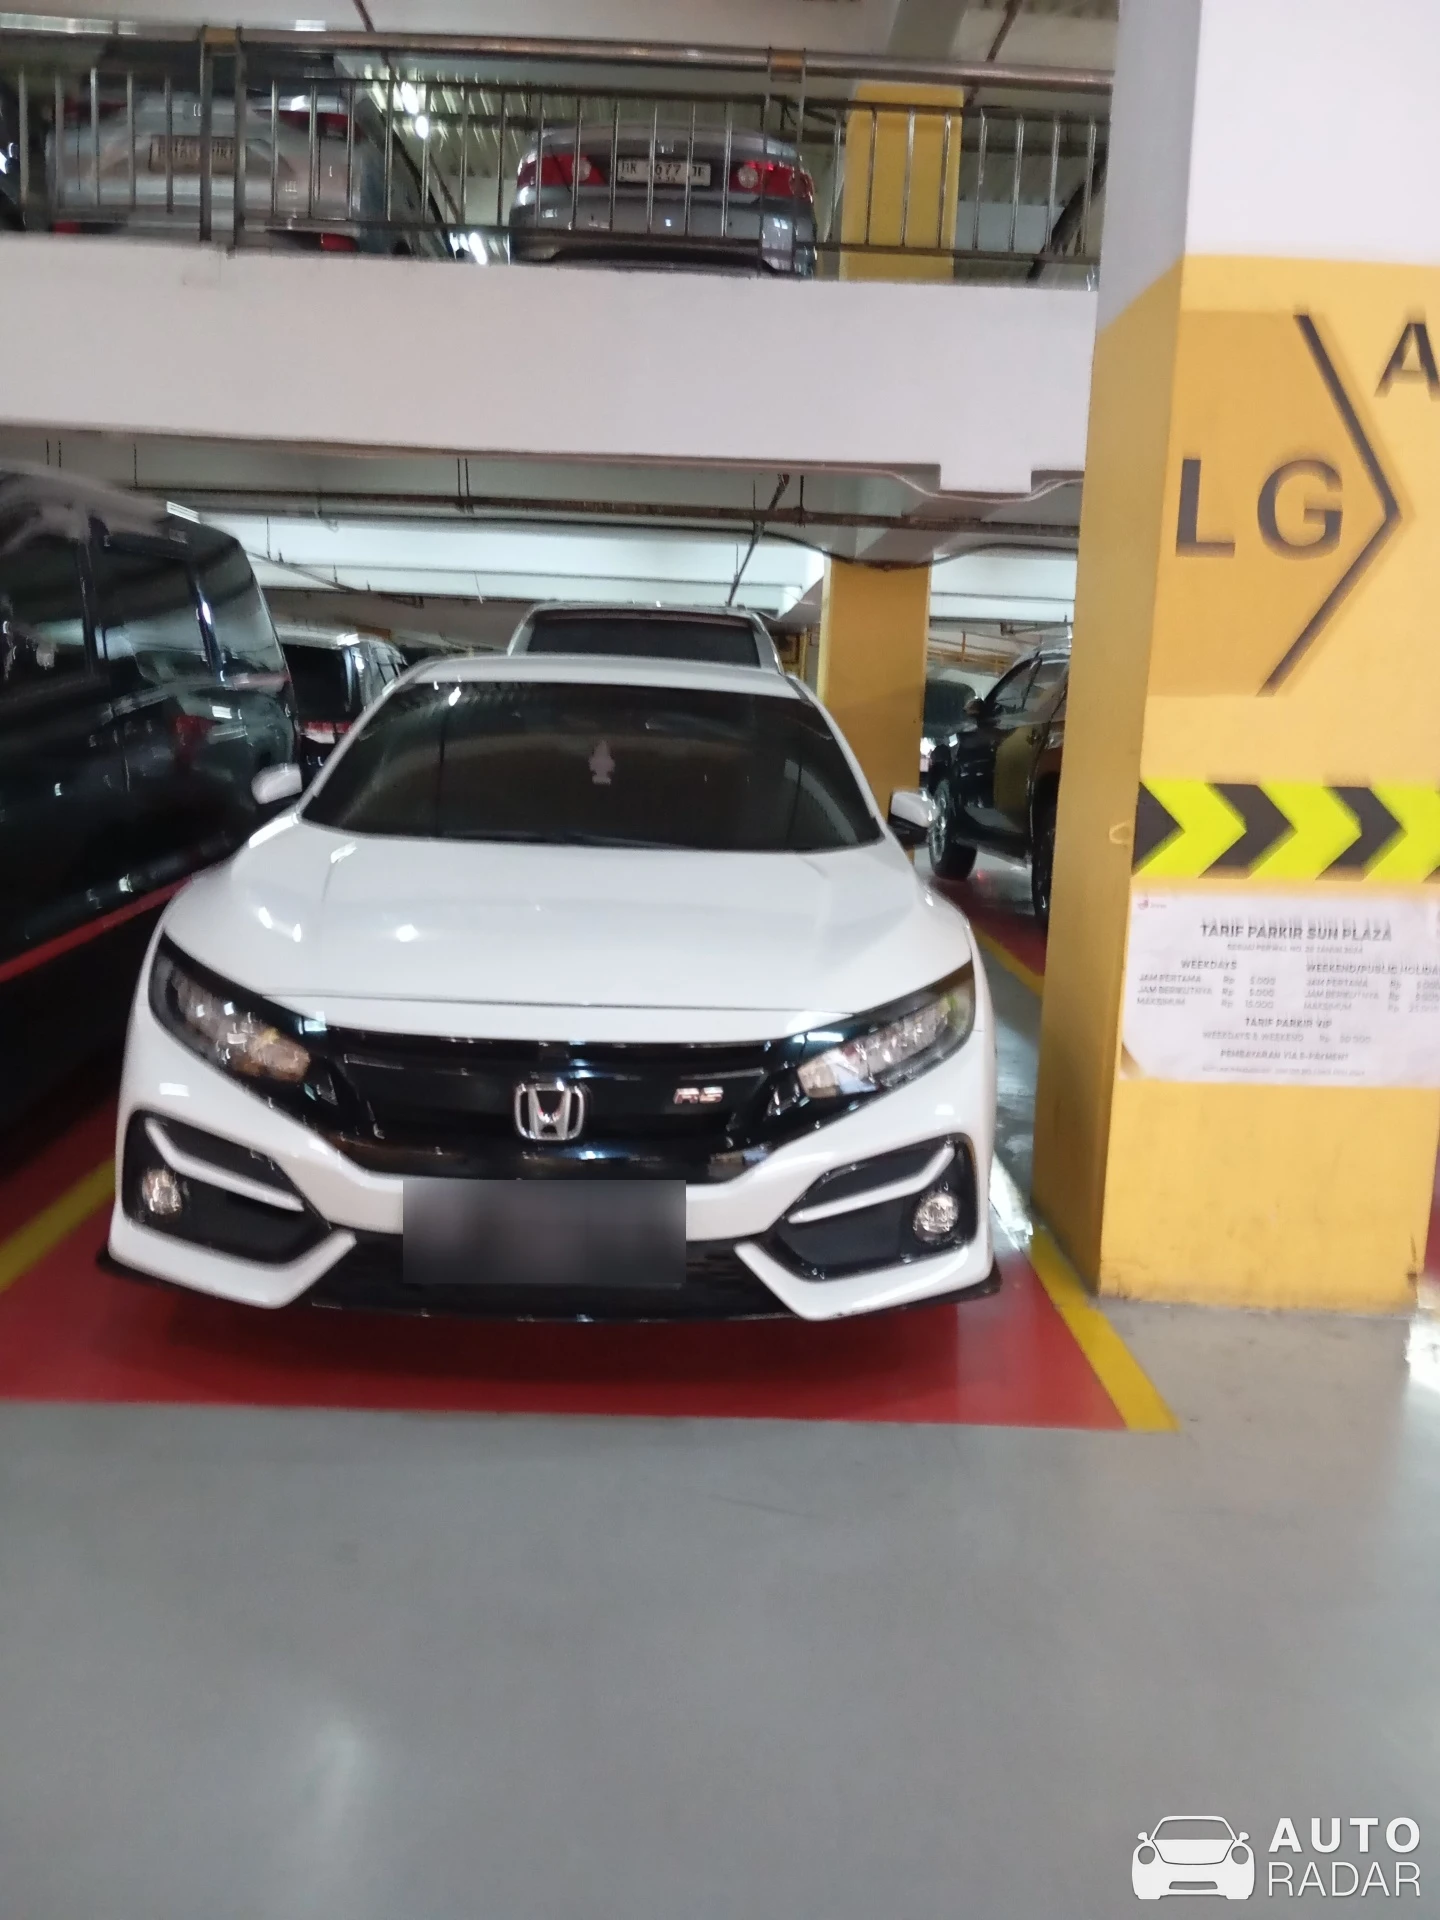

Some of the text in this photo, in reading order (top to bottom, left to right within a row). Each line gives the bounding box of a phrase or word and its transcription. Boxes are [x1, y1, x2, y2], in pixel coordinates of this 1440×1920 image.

[1200, 923, 1393, 942] TARIF PARKIR SUN PLAZA
[1180, 959, 1238, 970] WEEKDAYS
[1159, 974, 1202, 983] PERTAMA
[1223, 975, 1235, 985] Rp
[1221, 987, 1234, 997] Rp
[1220, 999, 1234, 1009] Rp
[1245, 1017, 1333, 1028] TARIF PARKIR VIP
[1202, 1030, 1250, 1040] WEEKDAYS
[1261, 1032, 1305, 1042] WEEKEND
